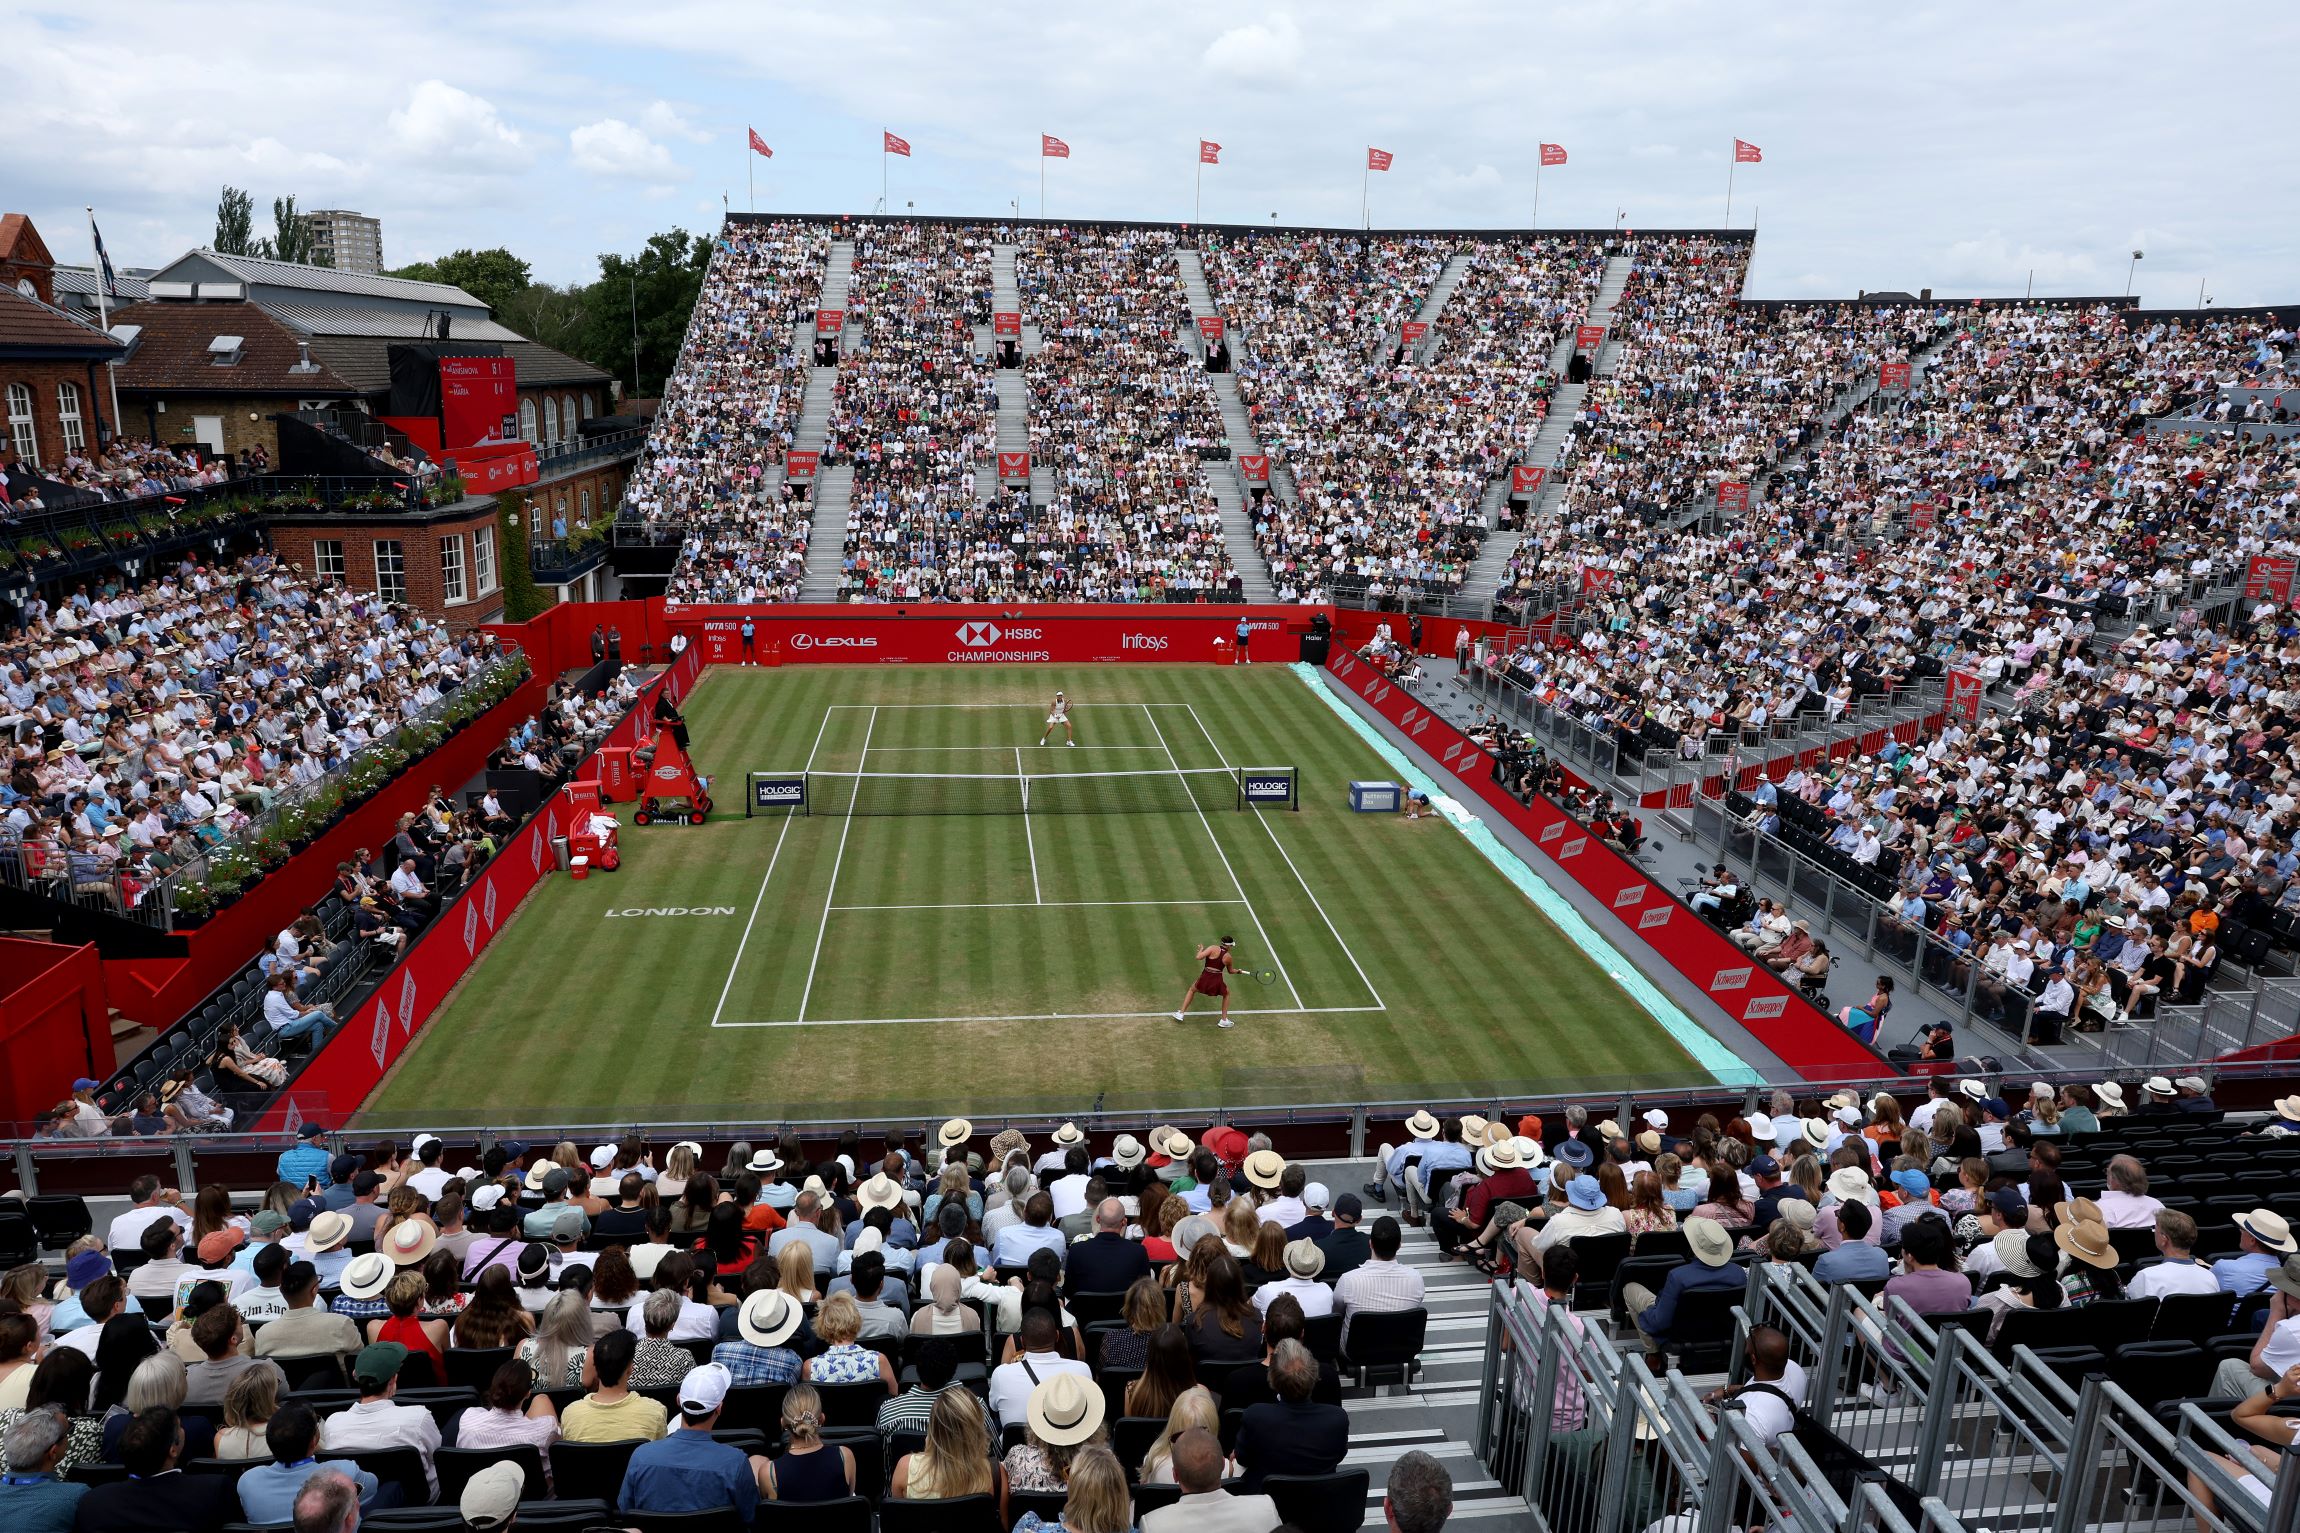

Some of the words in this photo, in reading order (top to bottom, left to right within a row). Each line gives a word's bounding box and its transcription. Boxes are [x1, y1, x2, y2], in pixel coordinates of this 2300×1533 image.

[453, 388, 470, 396] MARIA
[704, 622, 724, 631] WTA
[724, 622, 737, 631] 500
[1248, 622, 1267, 631] WTA
[1268, 622, 1279, 631] 500
[1004, 628, 1042, 640] HSBC
[814, 637, 878, 647] LEXUS
[1122, 632, 1169, 652] Infosys
[714, 643, 722, 653] 94
[947, 651, 1050, 662] CHAMPIONSHIPS
[760, 786, 801, 795] HOLOGIC
[1248, 782, 1288, 790] HOLOGIC
[1618, 889, 1643, 903] Schweppes
[604, 906, 736, 918] LONDON
[1642, 910, 1669, 924] Schweppes
[1714, 972, 1749, 986] Schweppes
[1748, 1000, 1784, 1014] Schweppes
[240, 1305, 262, 1318] alm
